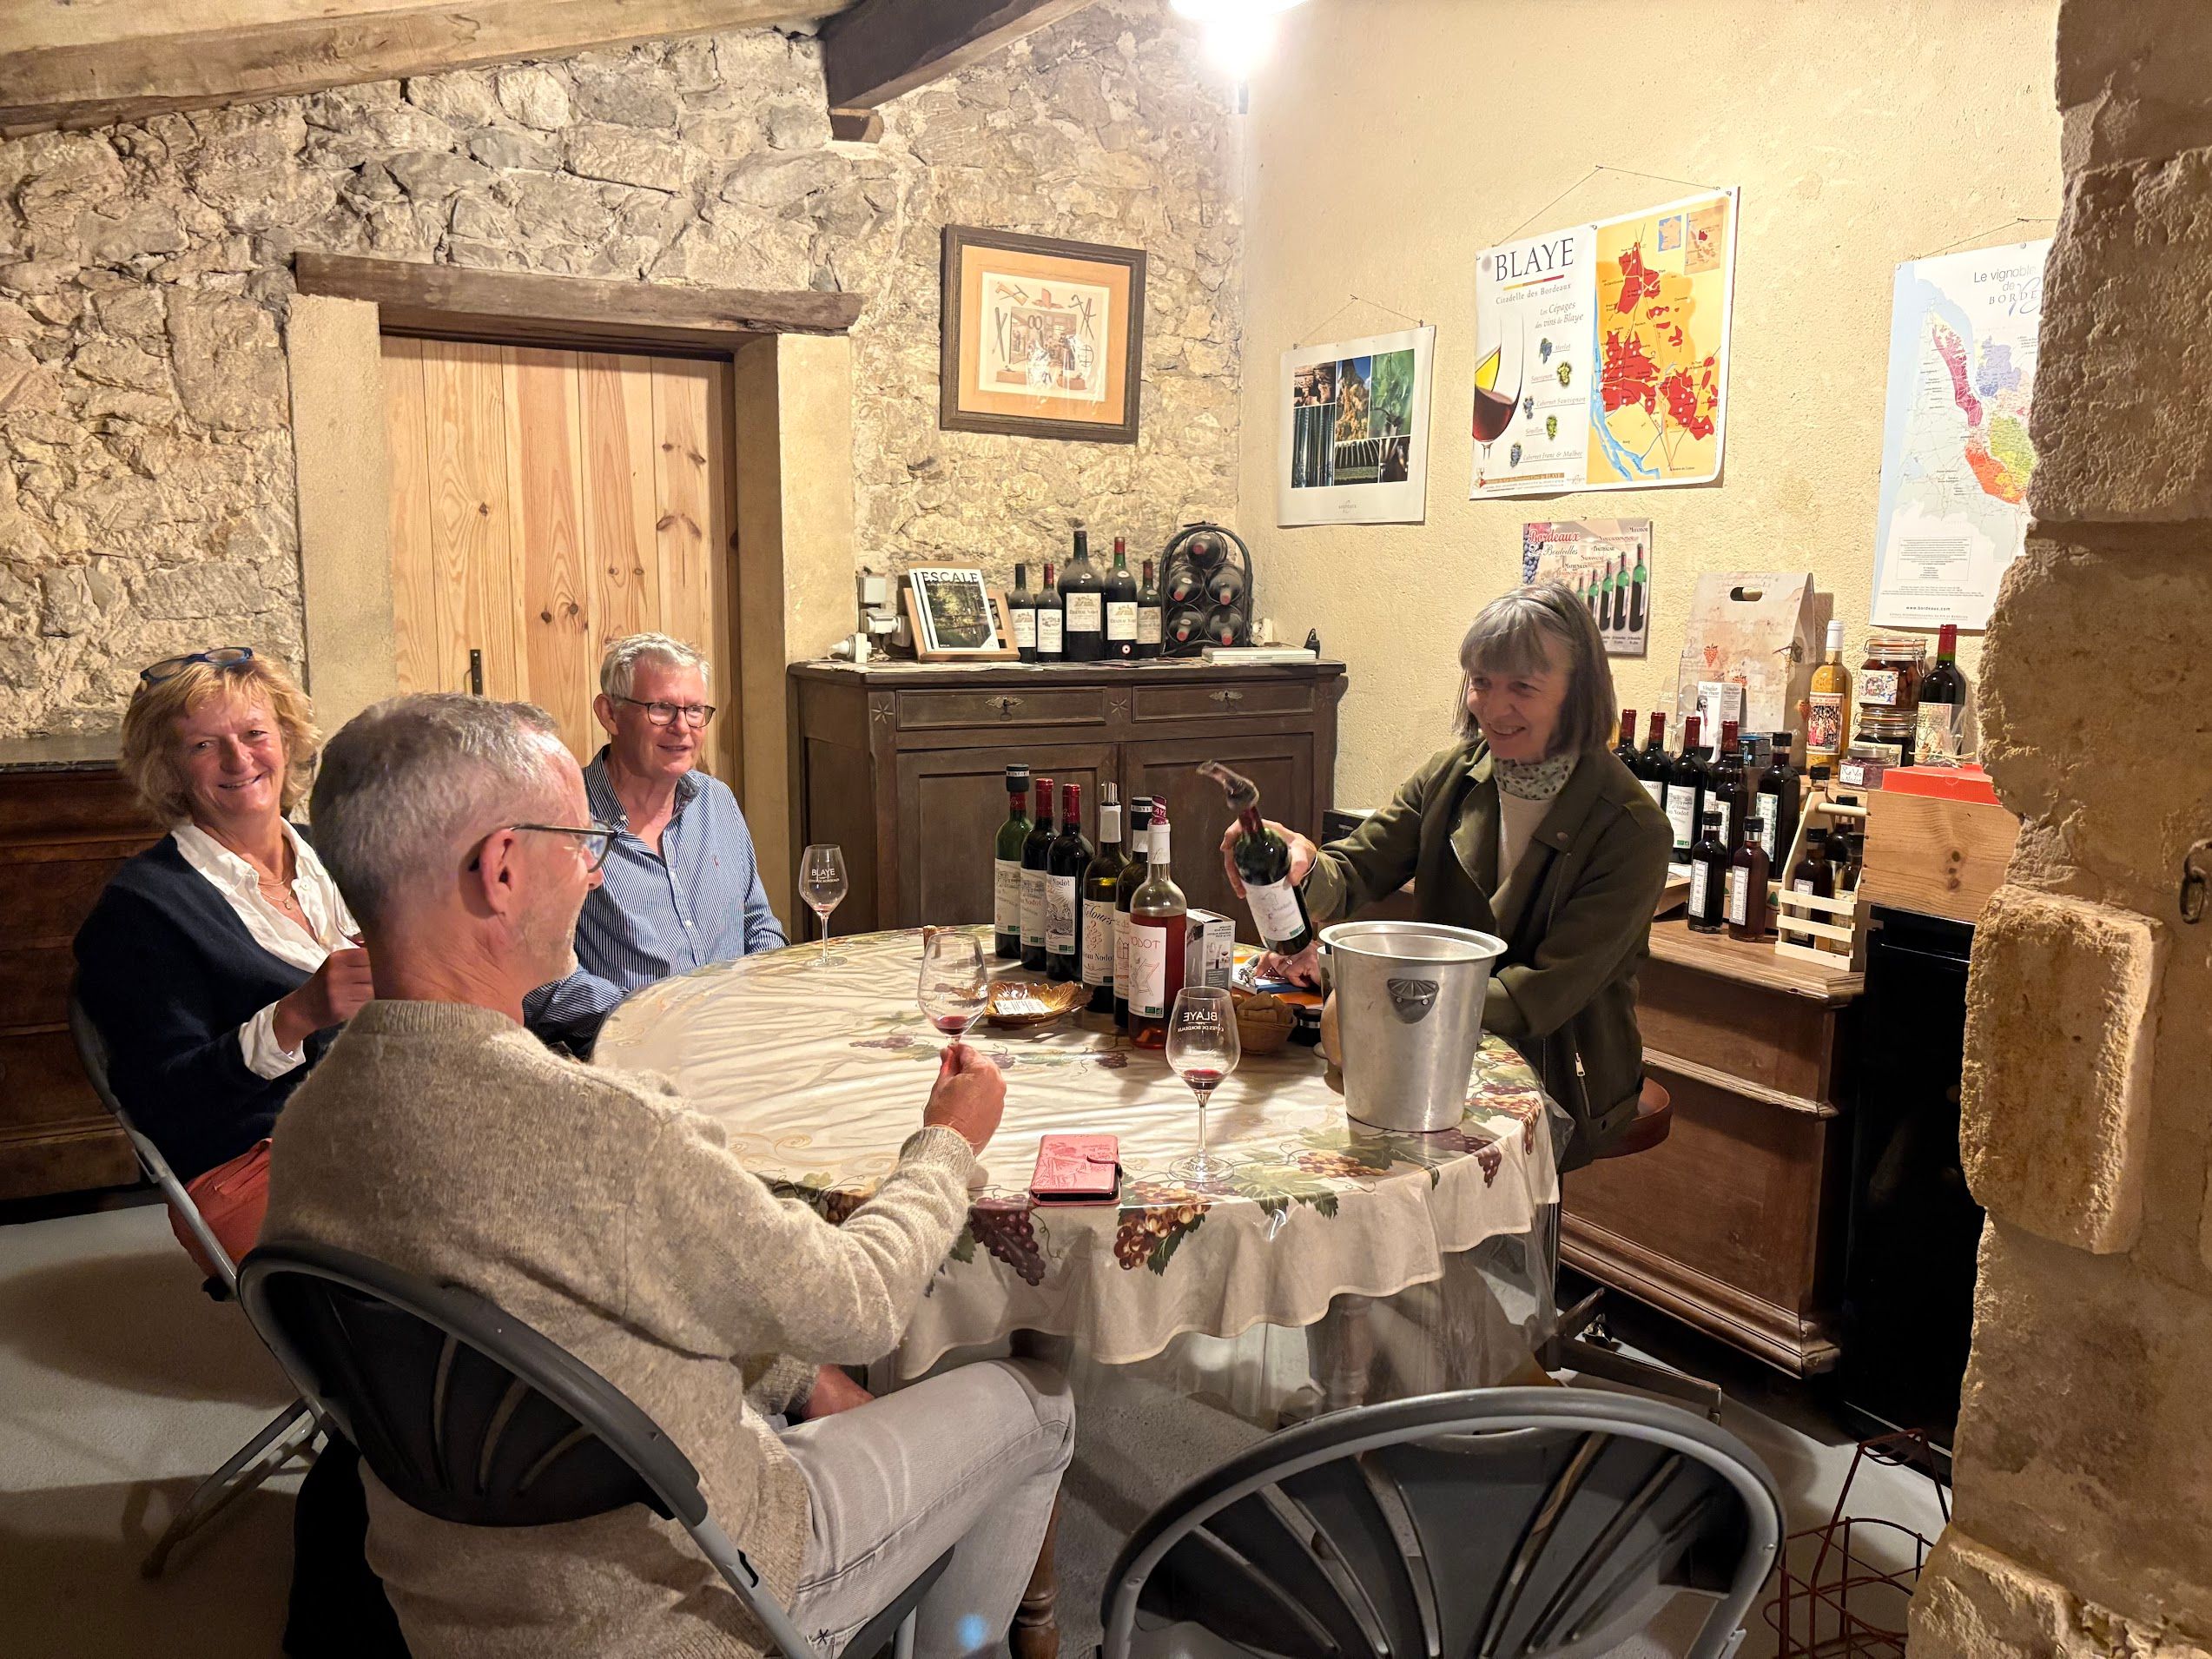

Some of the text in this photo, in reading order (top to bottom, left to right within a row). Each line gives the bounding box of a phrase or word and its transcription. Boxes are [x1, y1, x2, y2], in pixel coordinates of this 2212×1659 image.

[1495, 237, 1574, 281] BLAYE
[1974, 272, 1988, 283] Le
[2003, 281, 2015, 292] de
[1496, 282, 1571, 305] Citadelle des Bordeaux
[1548, 301, 1575, 314] Cépages
[1543, 317, 1556, 327] vins
[1563, 313, 1584, 325] Blaye
[1529, 528, 1580, 544] Bordeaux
[921, 572, 979, 583] ESCALE
[811, 868, 835, 876] BLAYE
[1052, 877, 1071, 887] Nodot
[1025, 897, 1041, 906] Nodot
[1131, 936, 1161, 949] ODOT
[1094, 954, 1113, 962] Nodo
